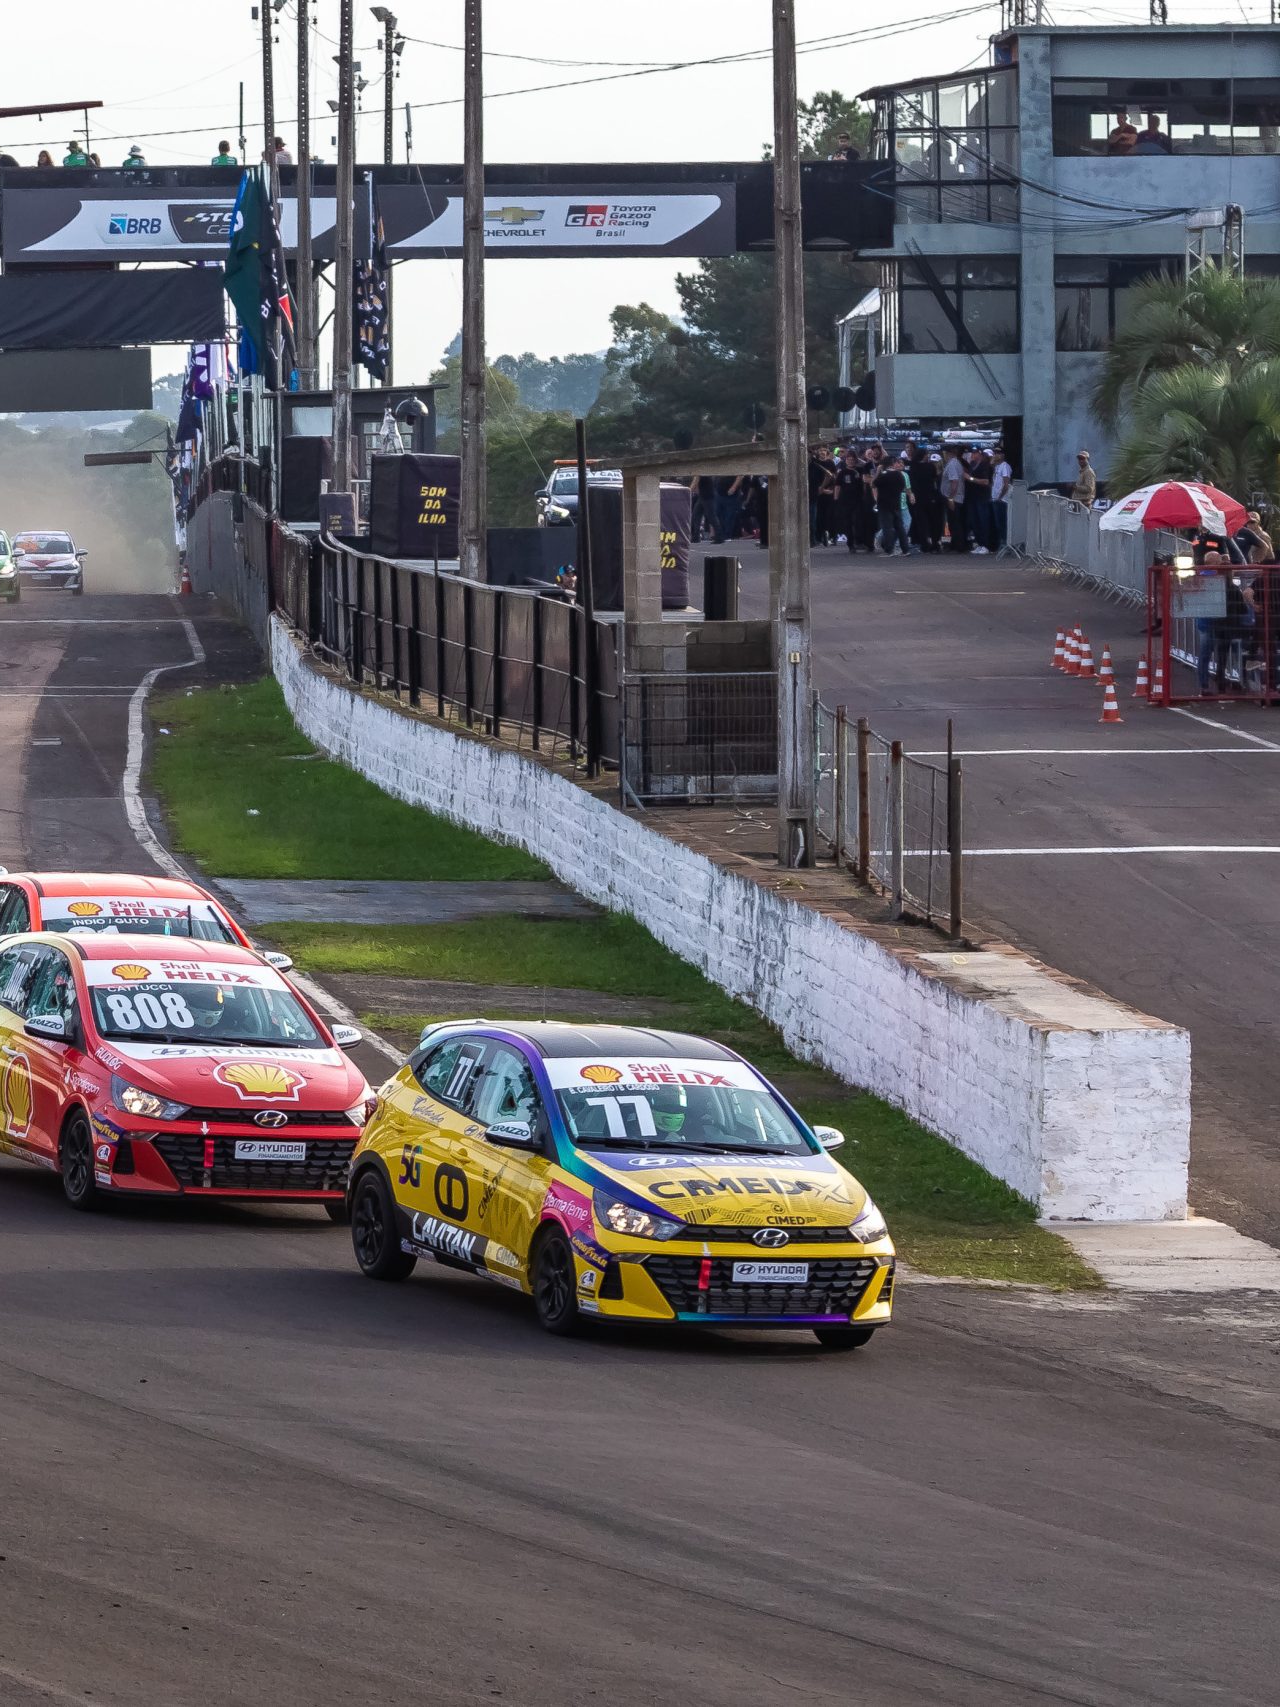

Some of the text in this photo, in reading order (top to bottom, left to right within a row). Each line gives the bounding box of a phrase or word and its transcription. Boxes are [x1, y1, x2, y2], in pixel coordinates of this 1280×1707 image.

[566, 213, 604, 227] GR
[608, 219, 650, 228] Racing
[126, 218, 162, 235] BRB
[206, 224, 231, 235] ca
[595, 229, 626, 237] Brasil
[420, 486, 447, 497] SOM
[424, 499, 441, 510] DA
[418, 513, 447, 524] ILHA
[108, 900, 145, 908] Shell
[111, 905, 194, 919] HELIX
[72, 918, 106, 926] INDIO
[114, 917, 150, 925] GUTO
[160, 962, 200, 970] Shell
[163, 969, 262, 985] HELIX
[107, 984, 173, 992] CATTUCCI
[106, 993, 195, 1030] 808
[95, 1047, 124, 1070] RUDLOG
[627, 1063, 673, 1073] Shell
[632, 1069, 739, 1088] HELIX
[258, 1144, 304, 1153] HYUNDAI
[398, 1143, 423, 1189] 5G
[682, 1155, 804, 1168] HYUNDAI
[544, 1190, 590, 1222] dermafeme
[766, 1215, 806, 1226] CIMED
[412, 1212, 478, 1262] LAVITAN
[571, 1236, 608, 1268] GOODYEAR
[757, 1265, 807, 1275] HYUNDAI
